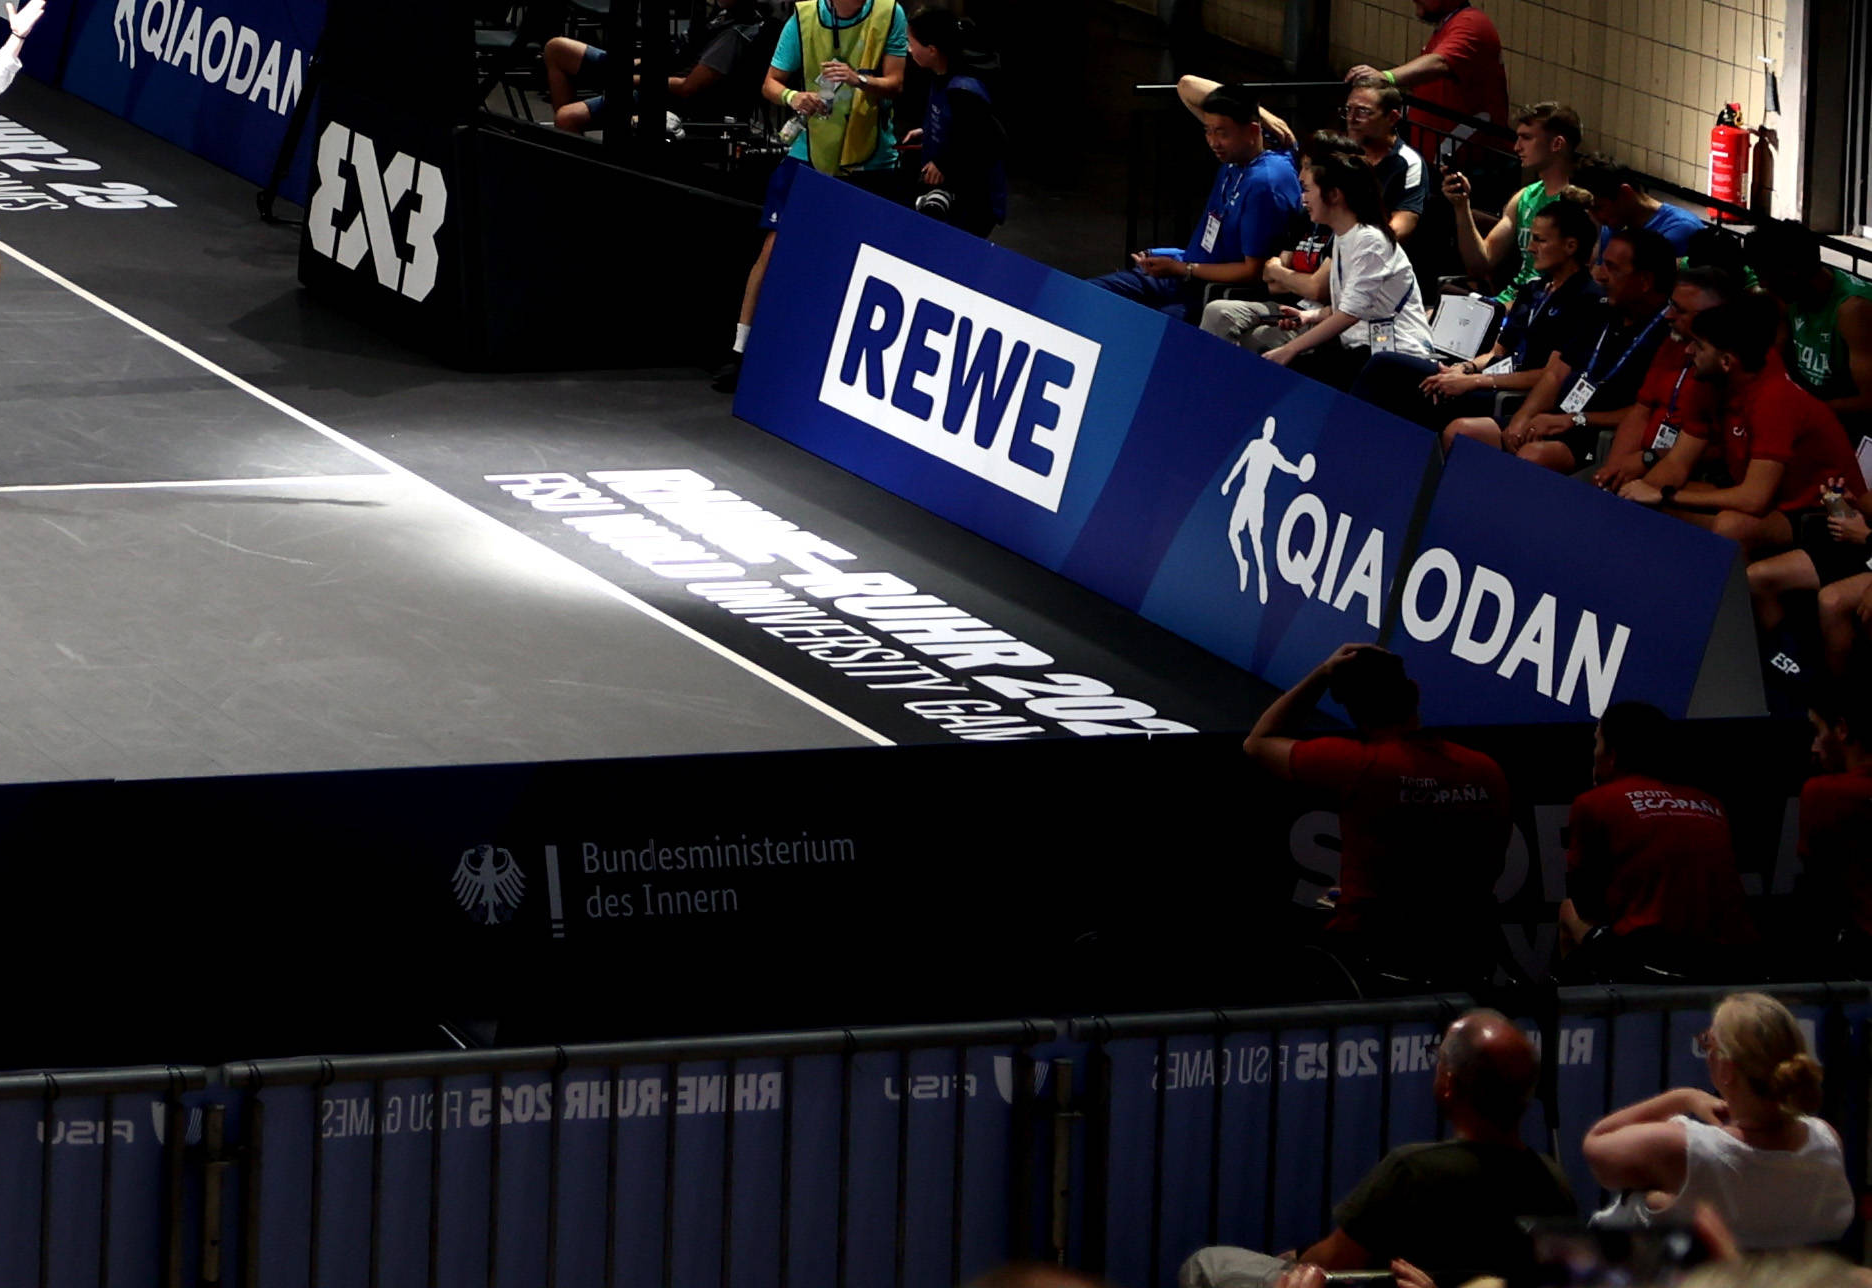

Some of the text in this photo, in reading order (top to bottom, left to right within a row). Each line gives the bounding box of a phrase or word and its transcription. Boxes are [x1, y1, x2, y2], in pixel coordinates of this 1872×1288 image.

[839, 275, 1075, 478] REWE
[686, 579, 972, 692] UNIVERSITY
[1769, 651, 1801, 678] ESP
[1625, 789, 1673, 802] Team
[581, 830, 857, 874] Bundesministerium
[585, 883, 738, 919] des Innern
